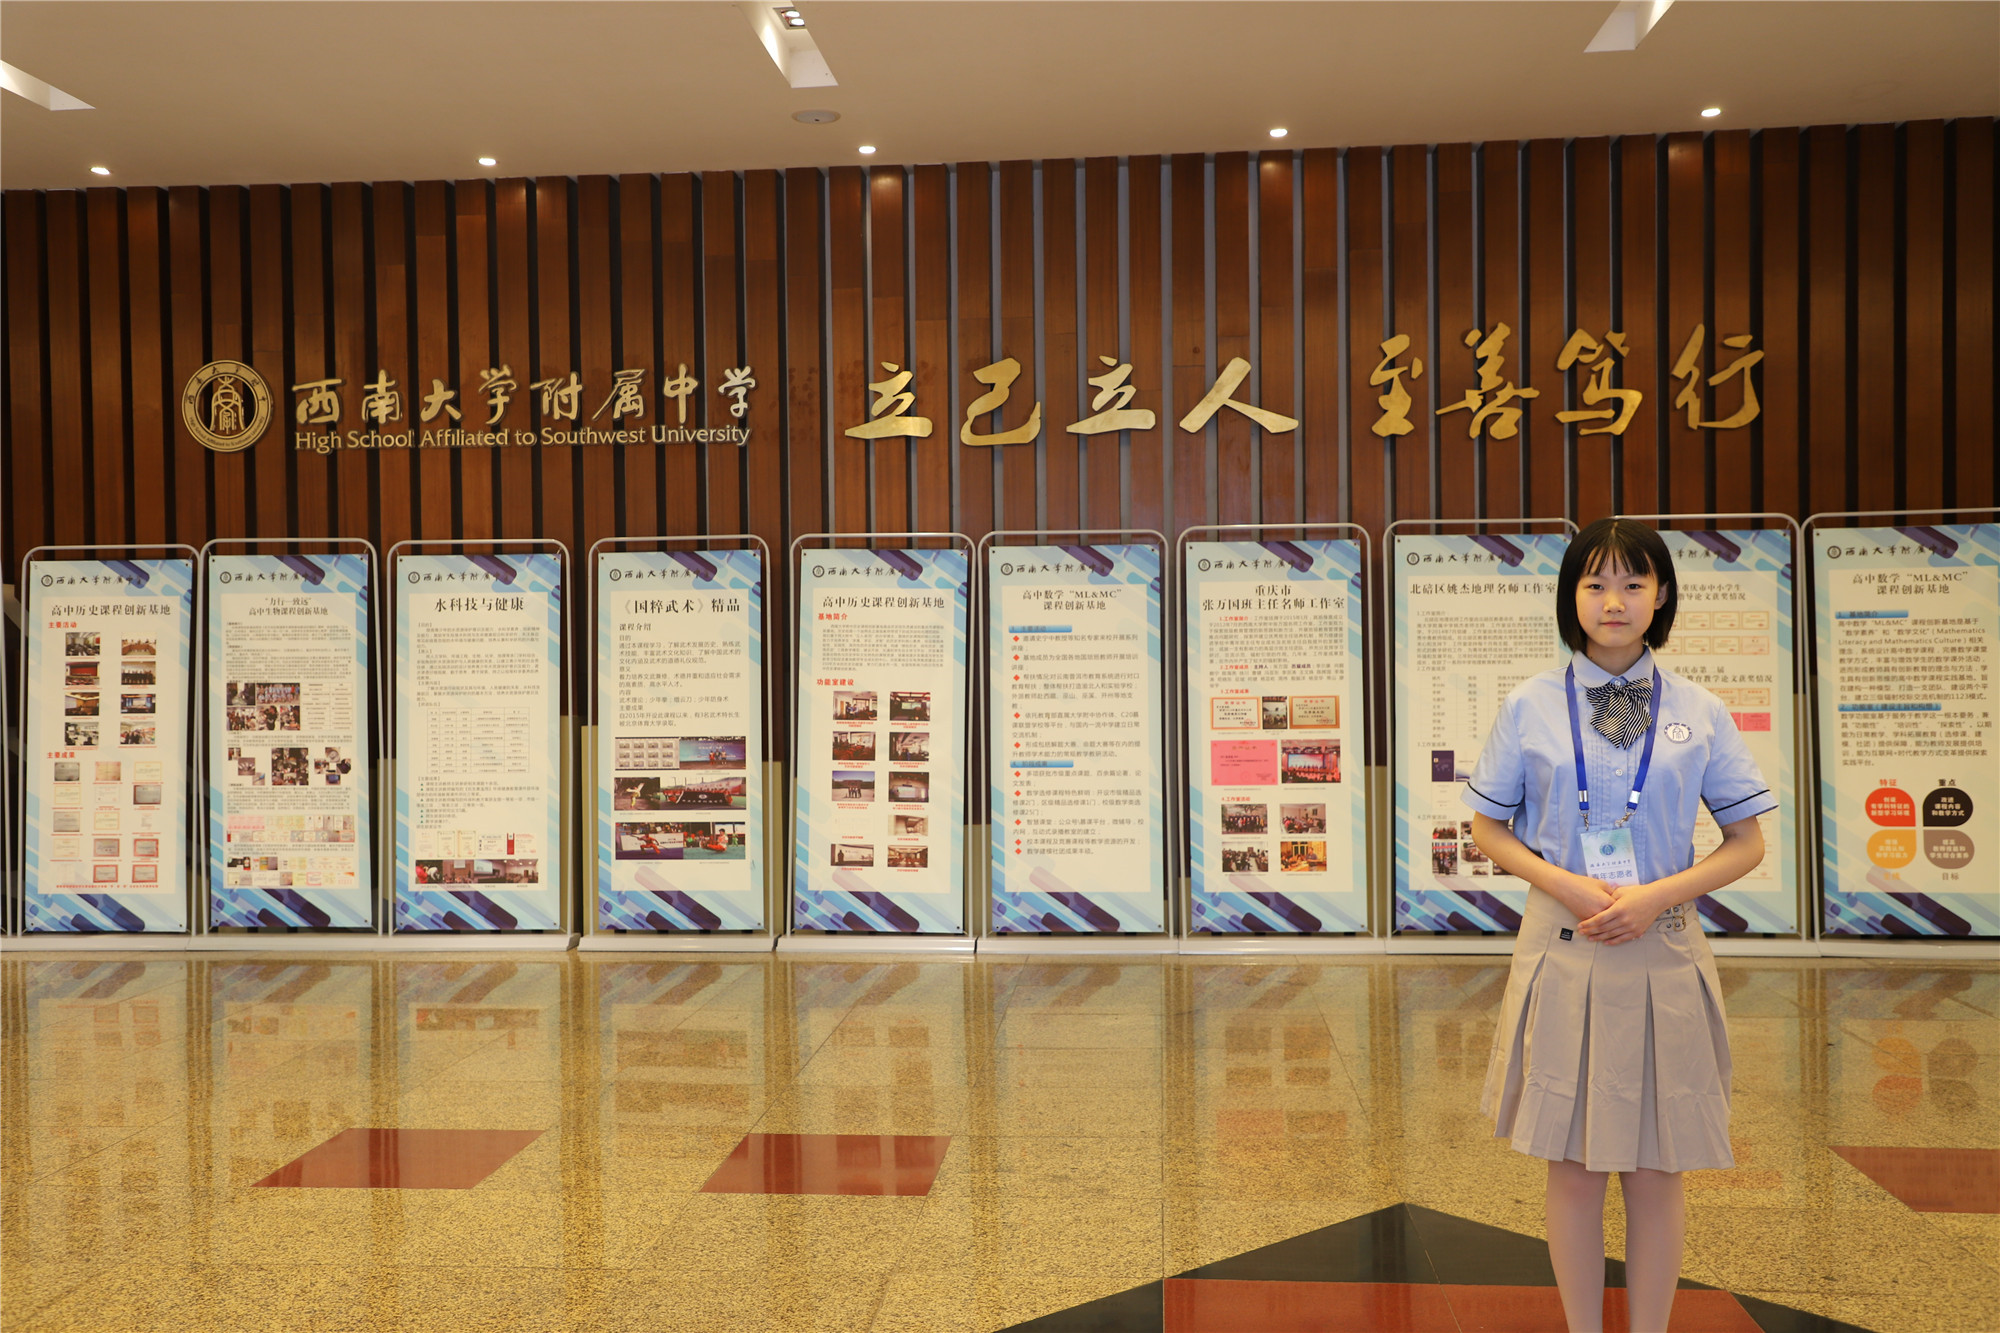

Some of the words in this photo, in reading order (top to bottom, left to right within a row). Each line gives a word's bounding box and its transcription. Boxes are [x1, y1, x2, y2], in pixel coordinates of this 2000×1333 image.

[1369, 322, 1764, 439] 至善笃行
[292, 364, 757, 427] 西南大学附属中学
[845, 356, 1298, 446] 立己立人
[295, 432, 342, 454] High
[347, 430, 414, 448] School
[418, 429, 508, 447] Affiliated
[514, 430, 536, 445] to
[541, 427, 646, 445] Southwest
[652, 425, 750, 446] University
[1255, 584, 1292, 596] 重庆市
[1410, 583, 1556, 594] 北碚区姚杰地理名师工作室
[1877, 585, 1950, 595] 课程创新基地
[435, 597, 524, 612] 水科技与健康
[625, 598, 740, 614] 《国粹武术》精品
[822, 596, 945, 609] 高中历史课程创新基地
[1044, 601, 1106, 610] 课程创新基地
[1202, 597, 1344, 610] 张万国班主任名师工作室
[51, 604, 171, 616] 高中历史课程创新基地
[249, 607, 328, 616] 高中生物课程创新基地
